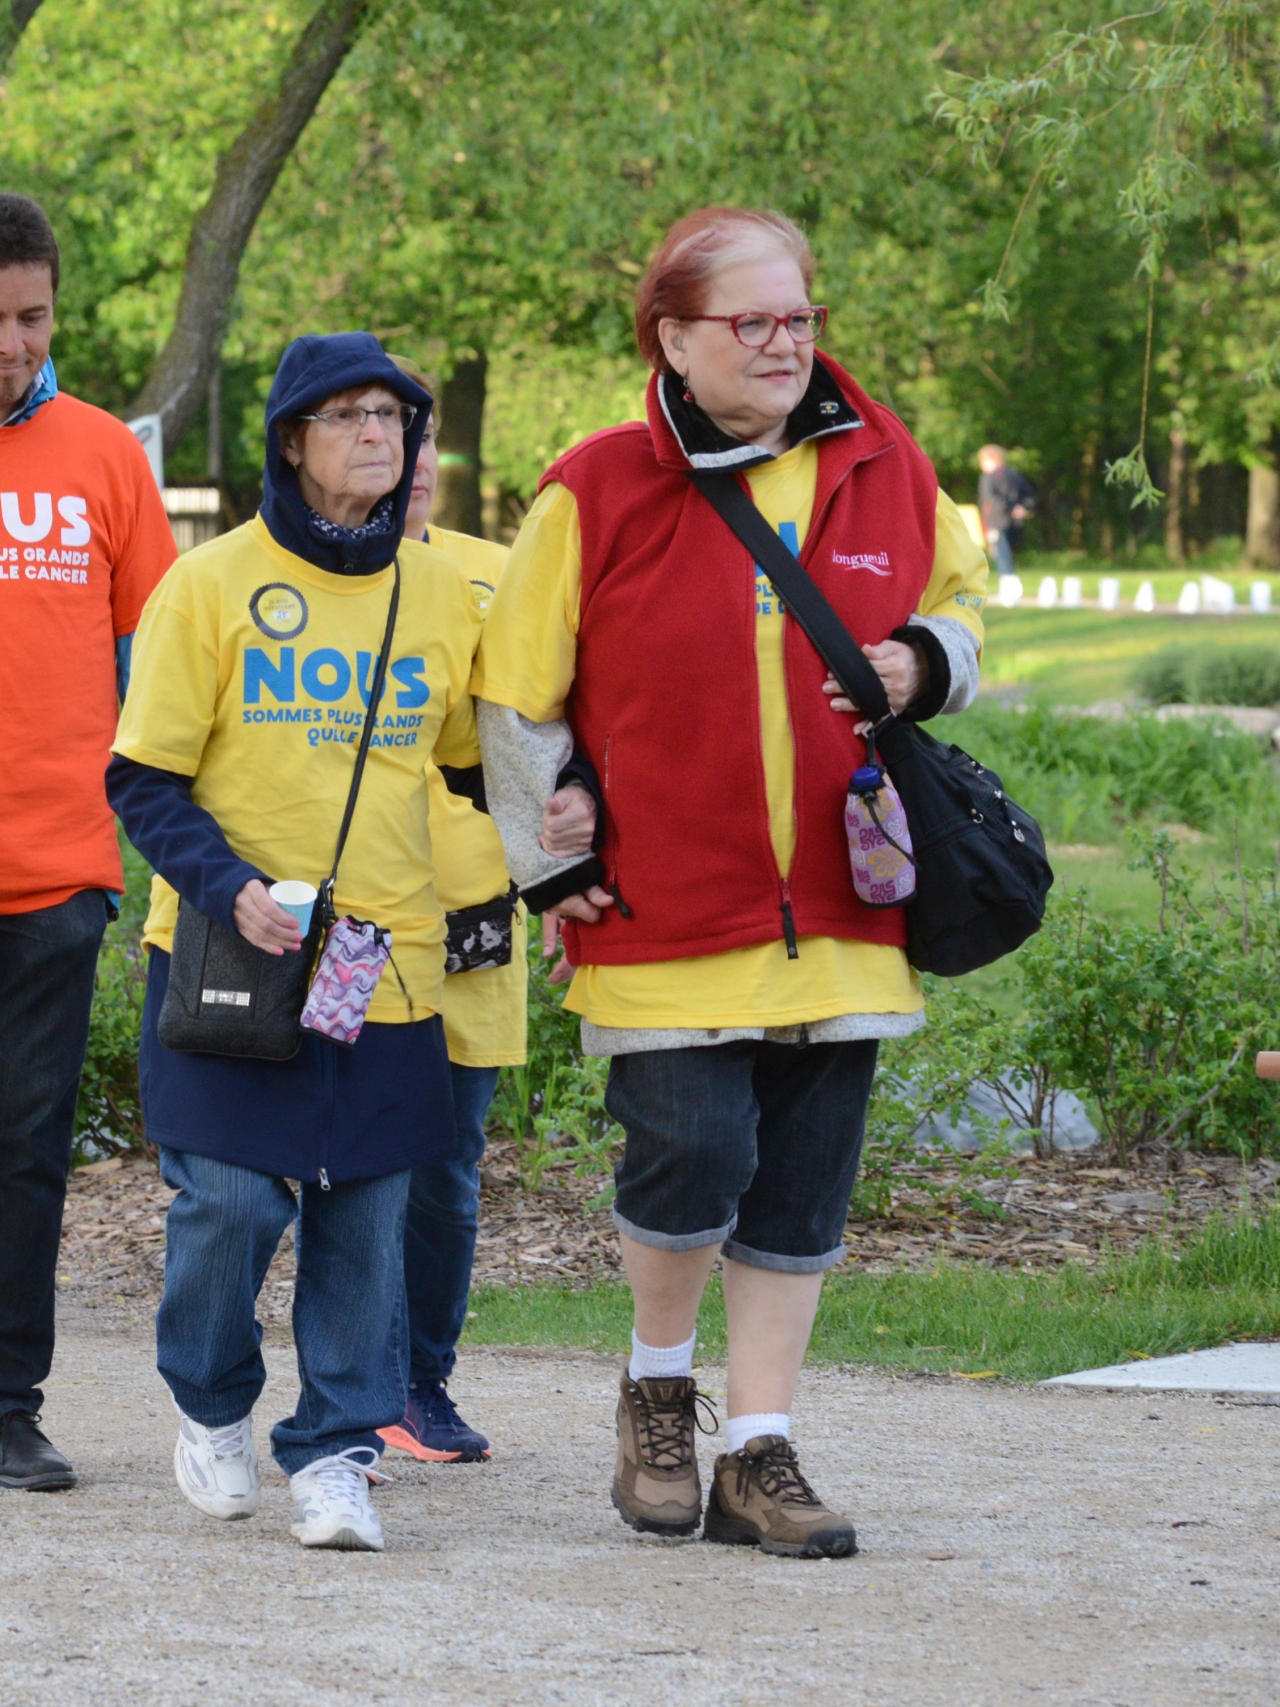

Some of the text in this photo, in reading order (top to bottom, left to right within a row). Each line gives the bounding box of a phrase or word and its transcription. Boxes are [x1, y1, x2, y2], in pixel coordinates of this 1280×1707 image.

[23, 547, 90, 567] GRANDS
[832, 549, 890, 569] longueuil
[24, 565, 88, 584] CANCER
[243, 646, 431, 709] NOUS
[242, 708, 425, 729] SOMMES PLUS RANDS
[368, 732, 418, 748] ANCER
